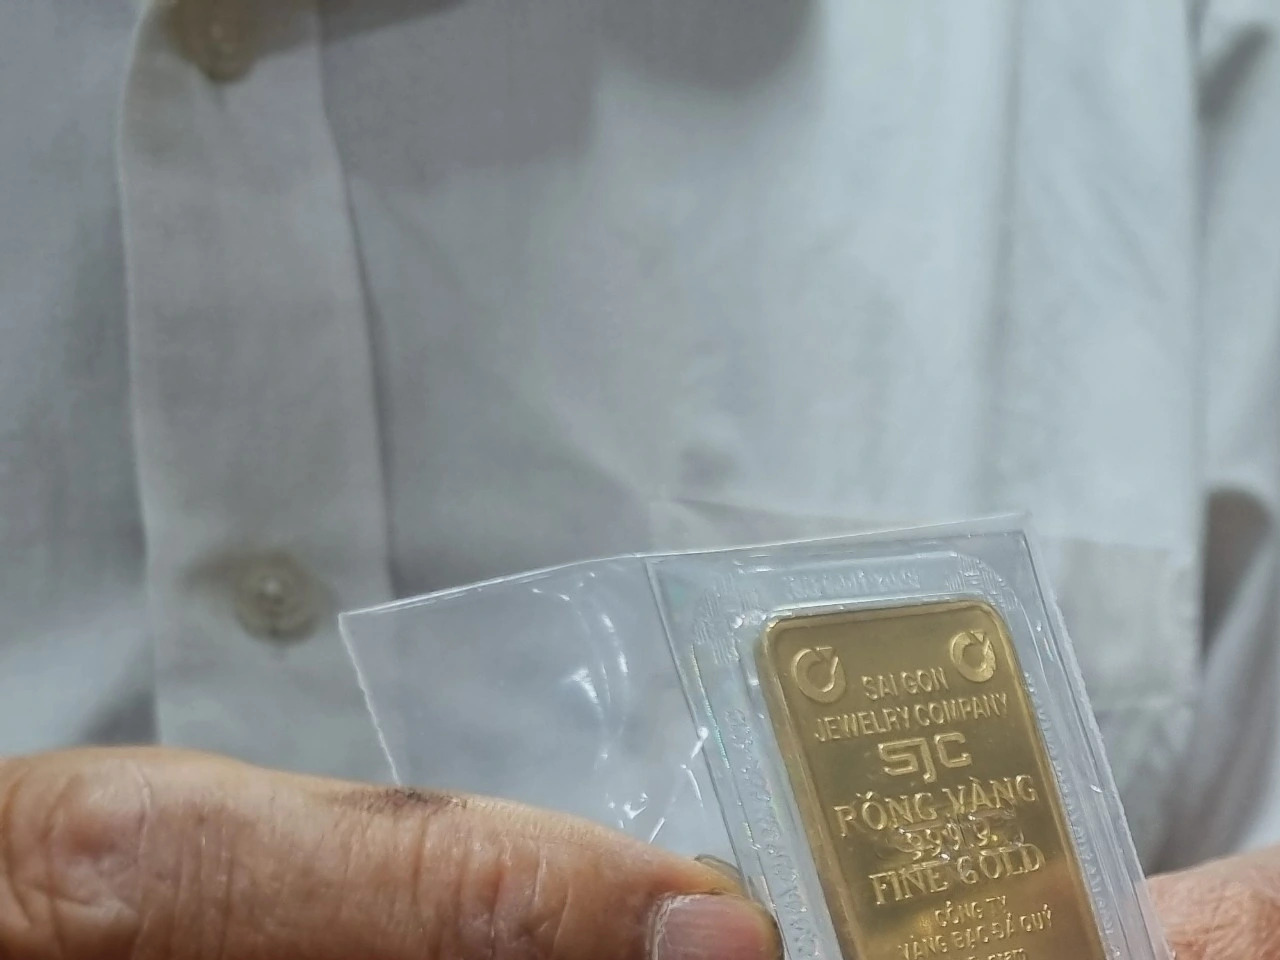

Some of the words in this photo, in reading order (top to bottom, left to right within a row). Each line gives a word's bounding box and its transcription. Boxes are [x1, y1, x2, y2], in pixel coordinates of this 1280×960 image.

[814, 706, 910, 742] JEWELRY
[914, 692, 1009, 727] COMPANY
[877, 731, 973, 784] SJC
[941, 774, 1039, 816] VÀNG
[868, 858, 949, 905] FINE
[956, 842, 1046, 885] GOLD
